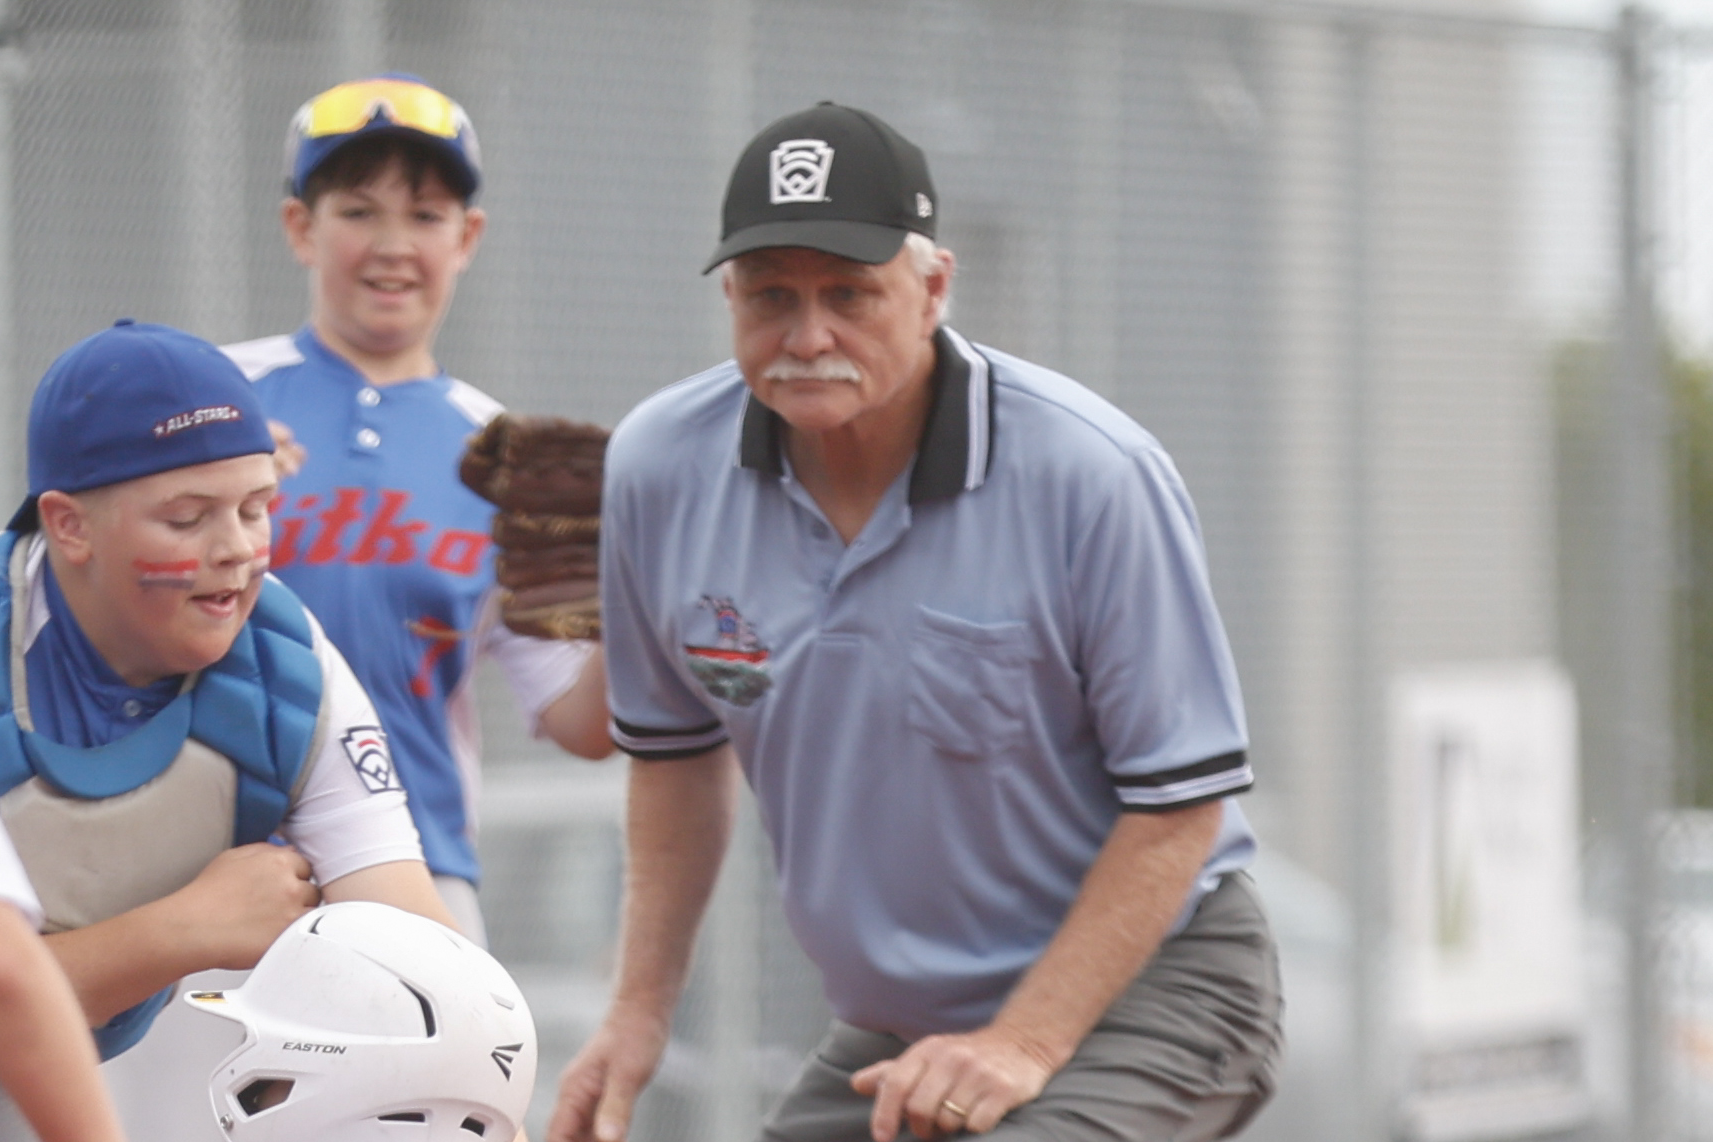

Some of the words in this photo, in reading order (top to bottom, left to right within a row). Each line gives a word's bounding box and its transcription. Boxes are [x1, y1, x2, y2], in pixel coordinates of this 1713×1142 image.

[166, 406, 231, 433] ALL-STARS
[267, 488, 493, 576] itka
[282, 1042, 347, 1054] EASTON
